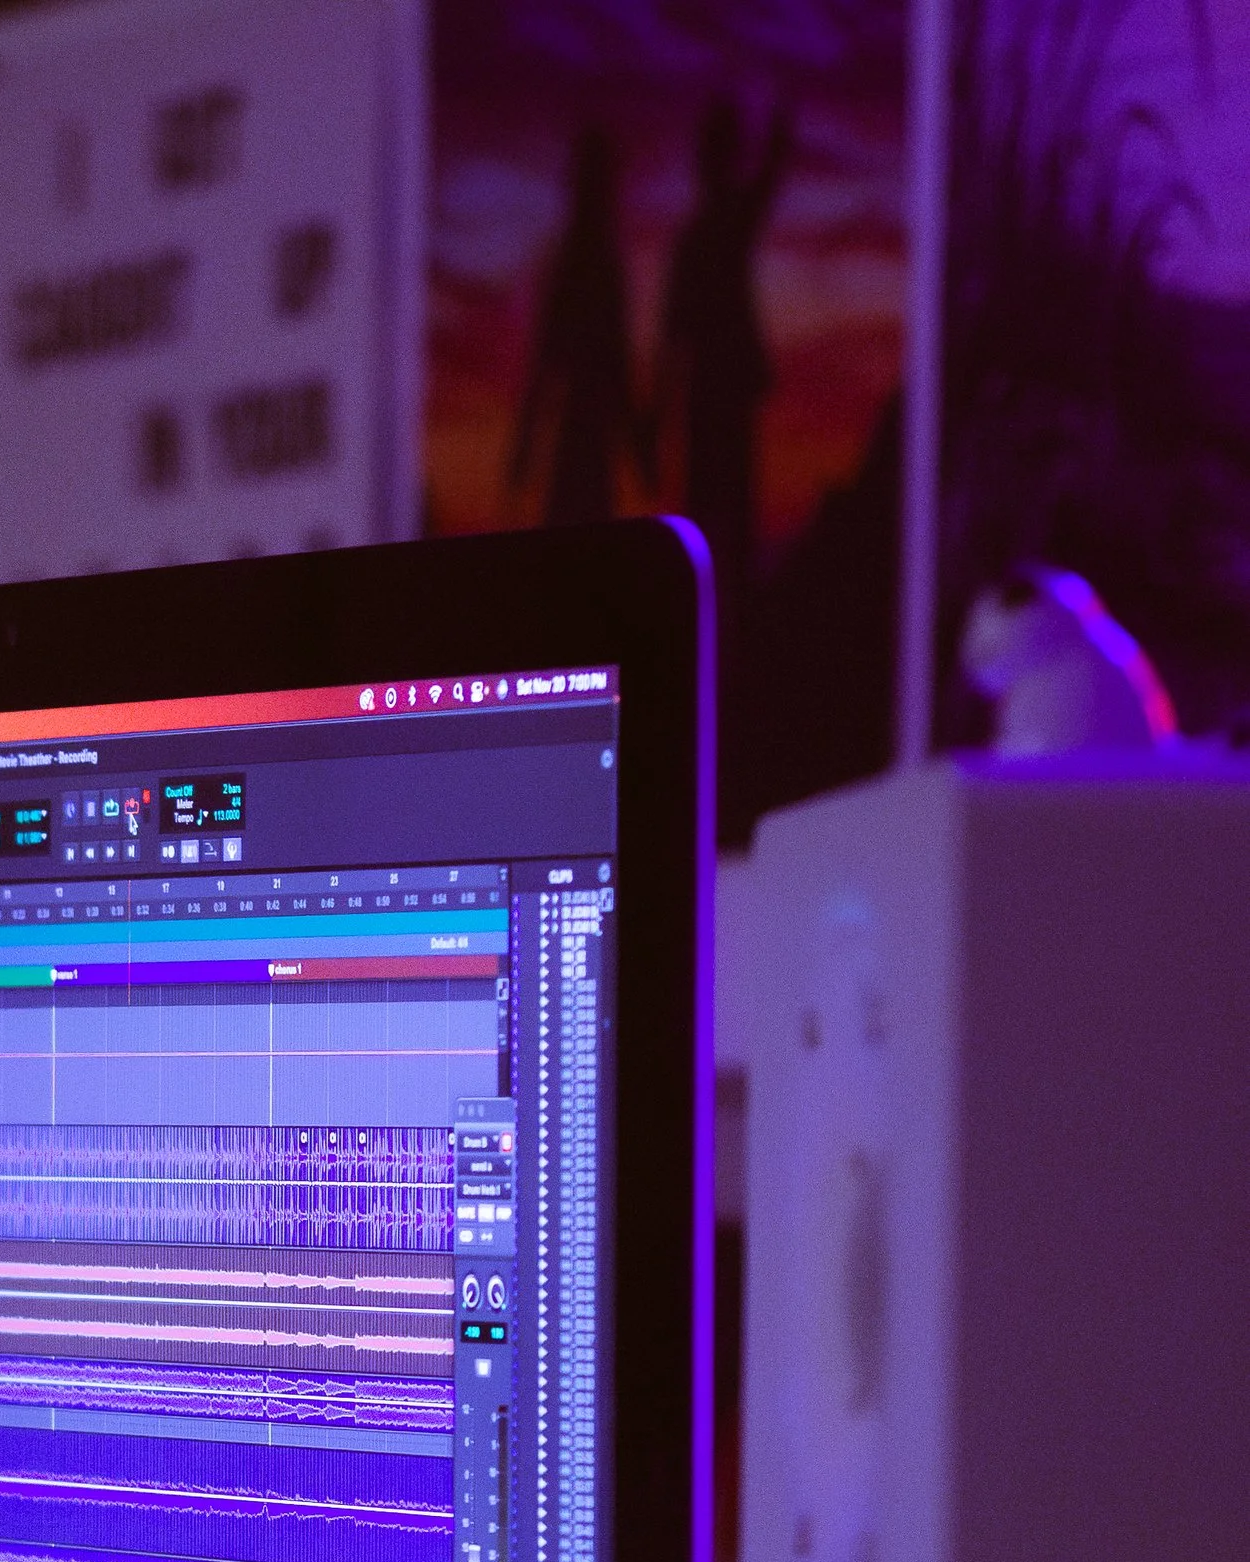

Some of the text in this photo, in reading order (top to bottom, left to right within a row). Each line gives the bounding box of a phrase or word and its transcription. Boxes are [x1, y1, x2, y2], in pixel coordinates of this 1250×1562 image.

[58, 748, 98, 765] Recording
[165, 783, 241, 798] Count Off 2 bars
[176, 798, 193, 809] Meter
[174, 812, 194, 825] Tempo
[273, 878, 281, 889] 21
[330, 875, 339, 887] 23
[390, 873, 399, 884] 25
[240, 901, 253, 911] 0:40
[266, 900, 280, 911] 0:42
[293, 899, 307, 910] 0:44
[321, 898, 335, 909] 0:46
[348, 897, 362, 907] 0:48
[275, 964, 297, 975] chorus
